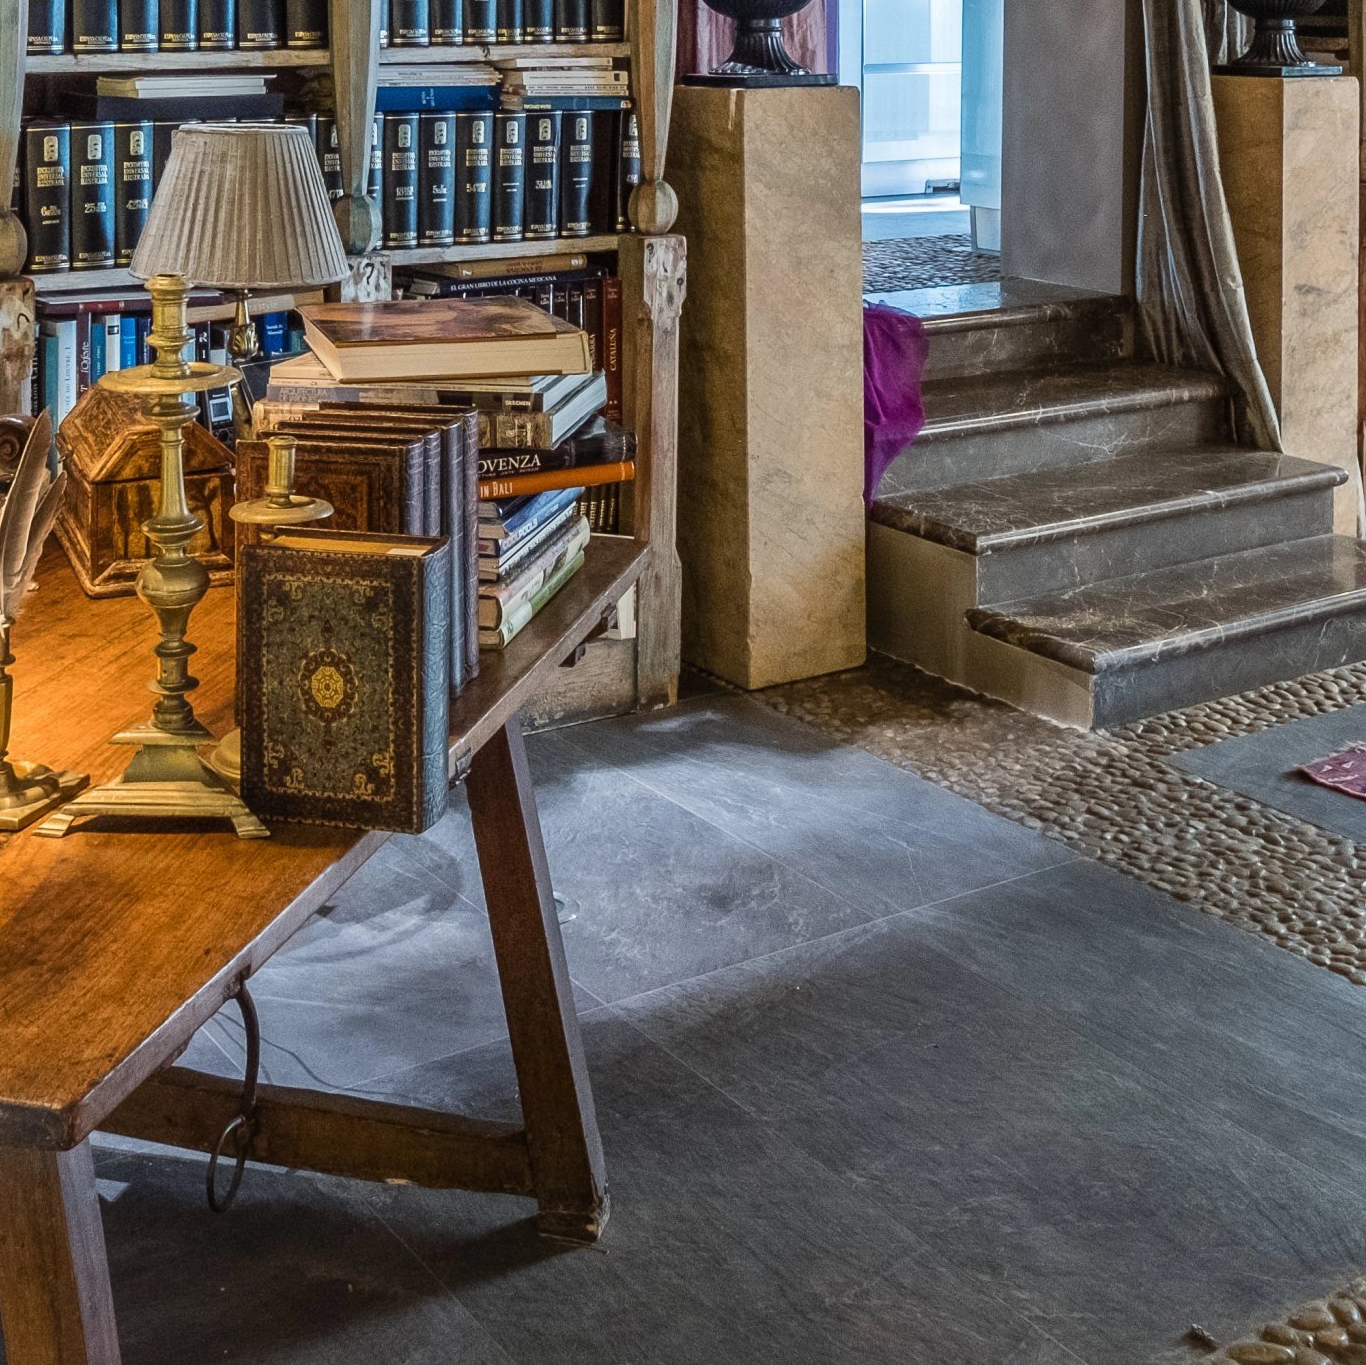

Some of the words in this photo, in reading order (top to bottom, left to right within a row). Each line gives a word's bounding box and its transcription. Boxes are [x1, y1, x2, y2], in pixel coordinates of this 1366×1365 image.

[474, 281, 490, 289] LIBRO
[507, 277, 528, 285] COCINA
[529, 275, 557, 284] MEXICANA
[609, 329, 617, 371] CATALUÑA
[478, 454, 541, 474] OVENZA
